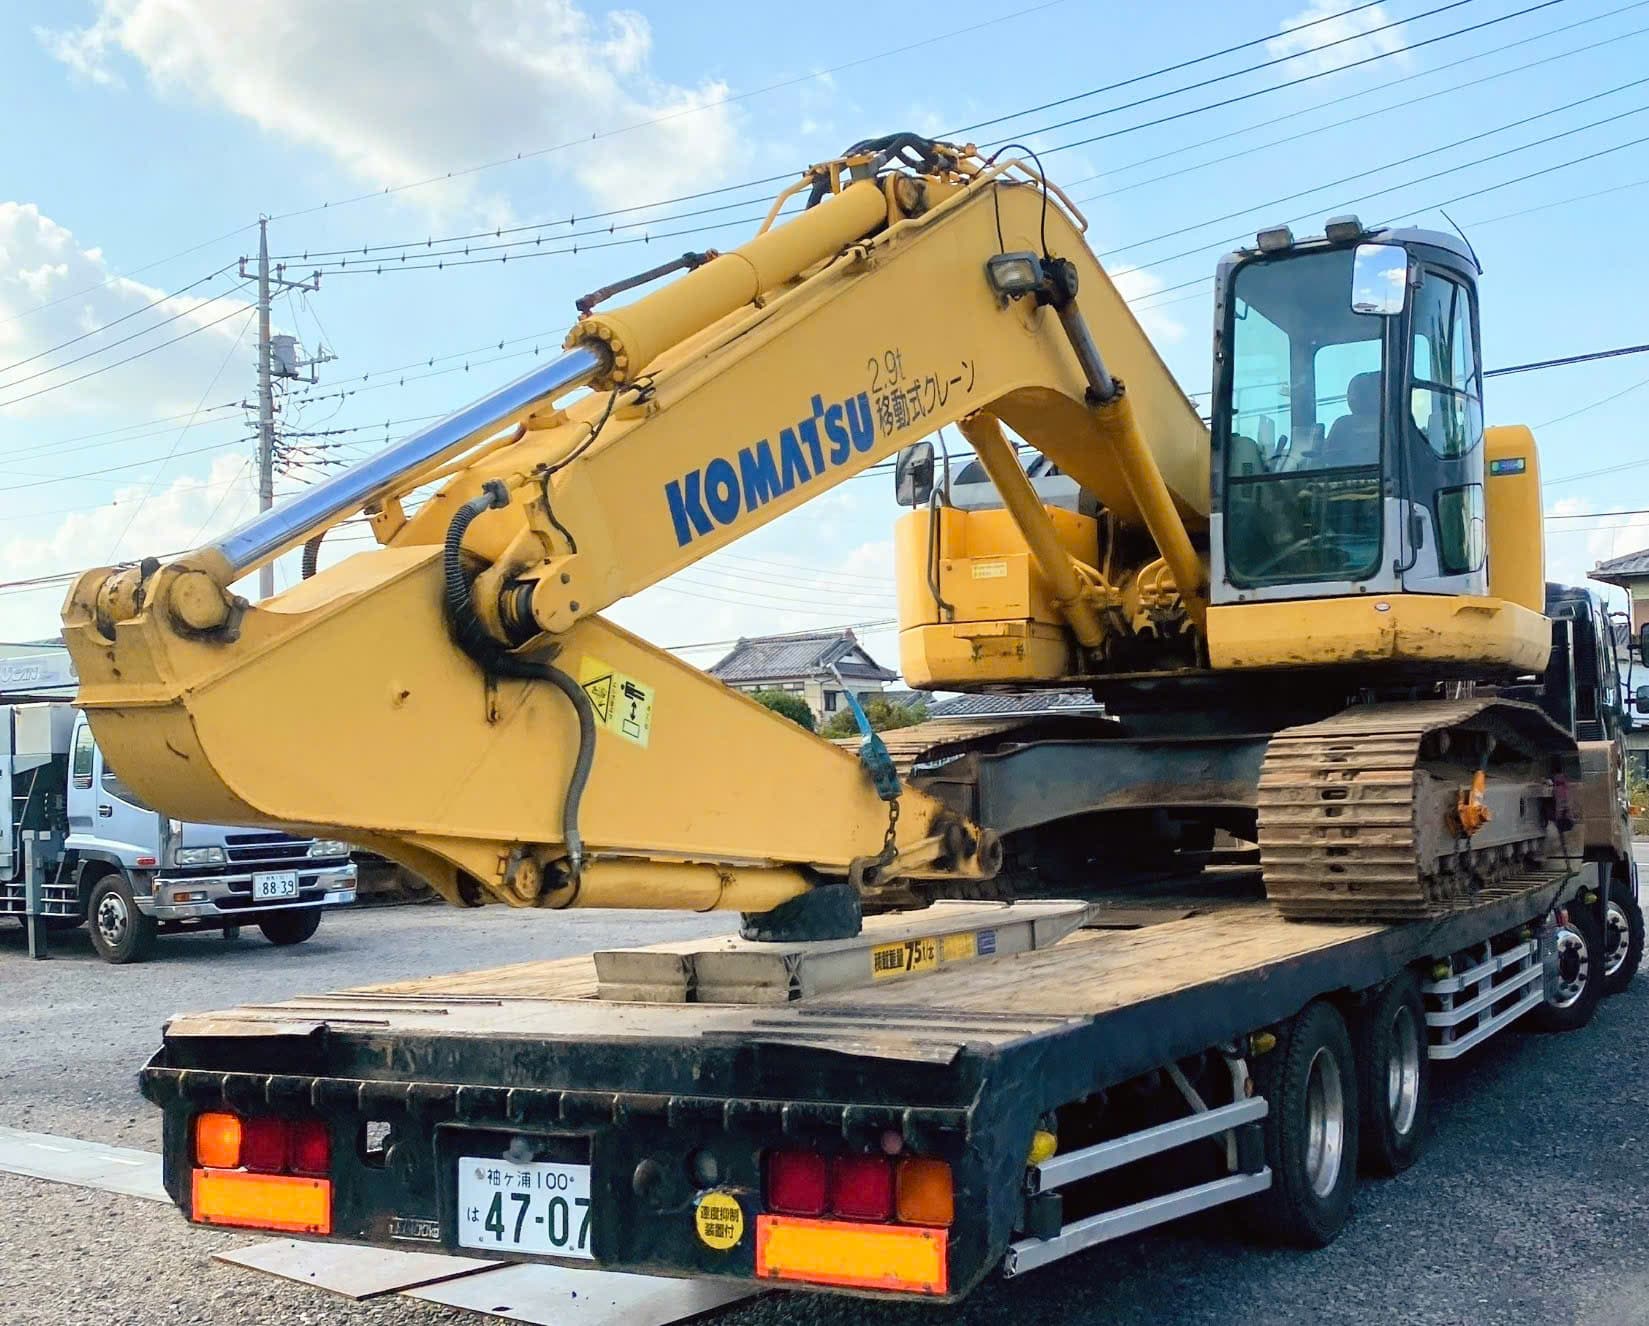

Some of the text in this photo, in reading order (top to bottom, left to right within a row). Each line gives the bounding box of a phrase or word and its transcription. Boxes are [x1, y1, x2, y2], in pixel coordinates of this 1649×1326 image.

[867, 347, 905, 394] 2.9t
[876, 360, 974, 437] 移動式クレーン
[664, 392, 875, 547] KOMATSU
[537, 1171, 568, 1190] 100
[467, 1192, 590, 1249] は 47-07
[700, 1205, 739, 1222] 速度抑制
[704, 1222, 735, 1239] 装置付
